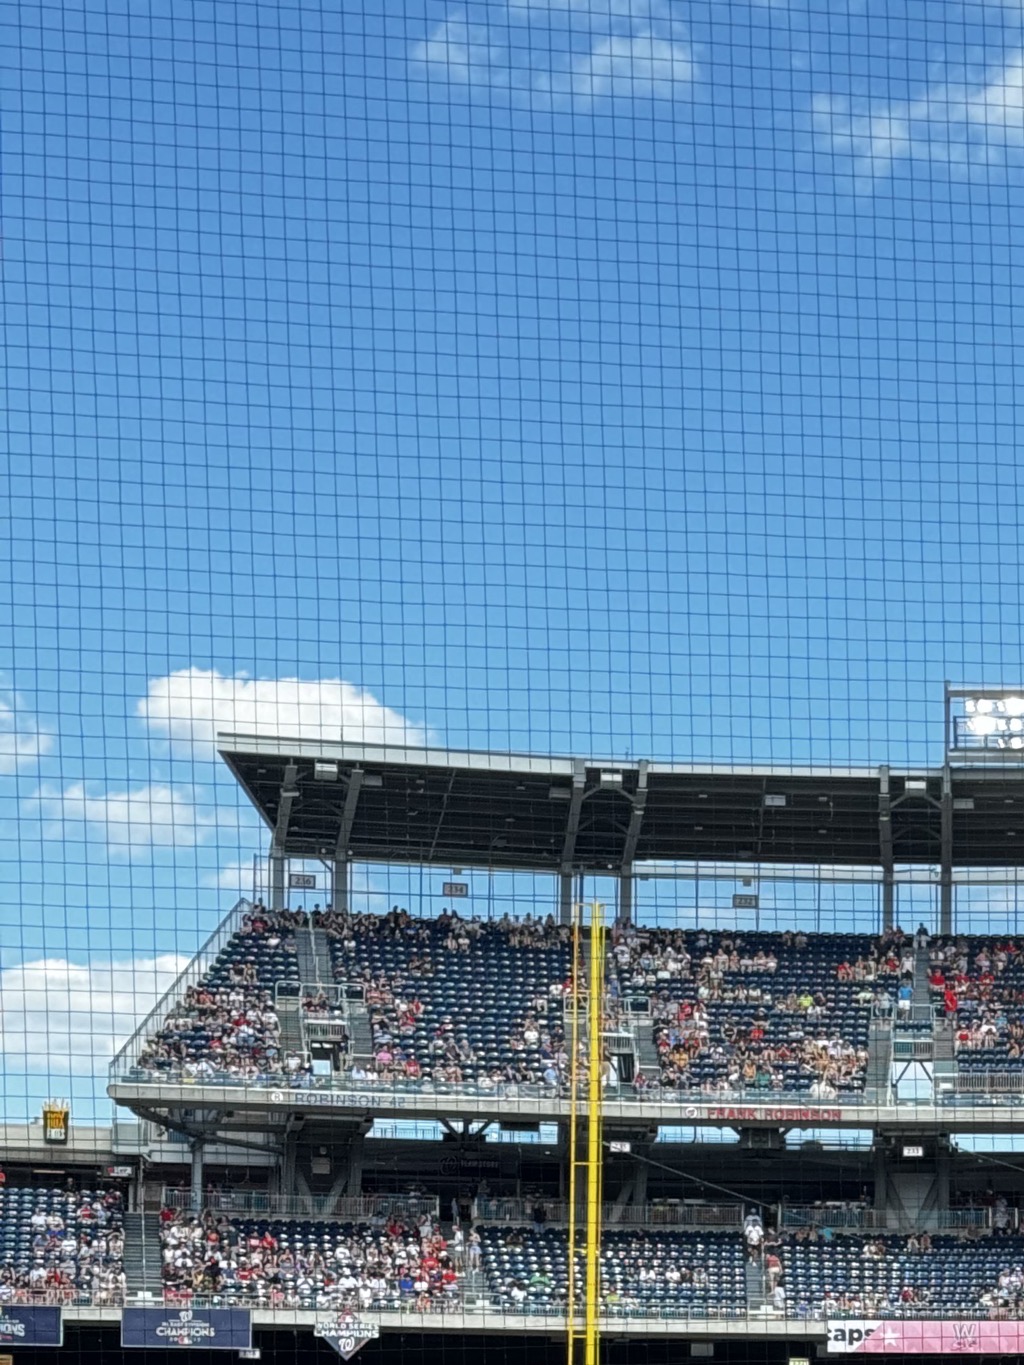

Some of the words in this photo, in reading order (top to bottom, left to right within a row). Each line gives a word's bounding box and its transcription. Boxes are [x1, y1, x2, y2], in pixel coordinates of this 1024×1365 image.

[294, 1093, 381, 1106] ROBINSON
[707, 1108, 757, 1119] FRANK
[764, 1109, 842, 1121] ROBINSON
[155, 1326, 216, 1337] CHAMPIONS
[317, 1322, 347, 1330] WORLD
[314, 1328, 380, 1338] CHAMPIONS
